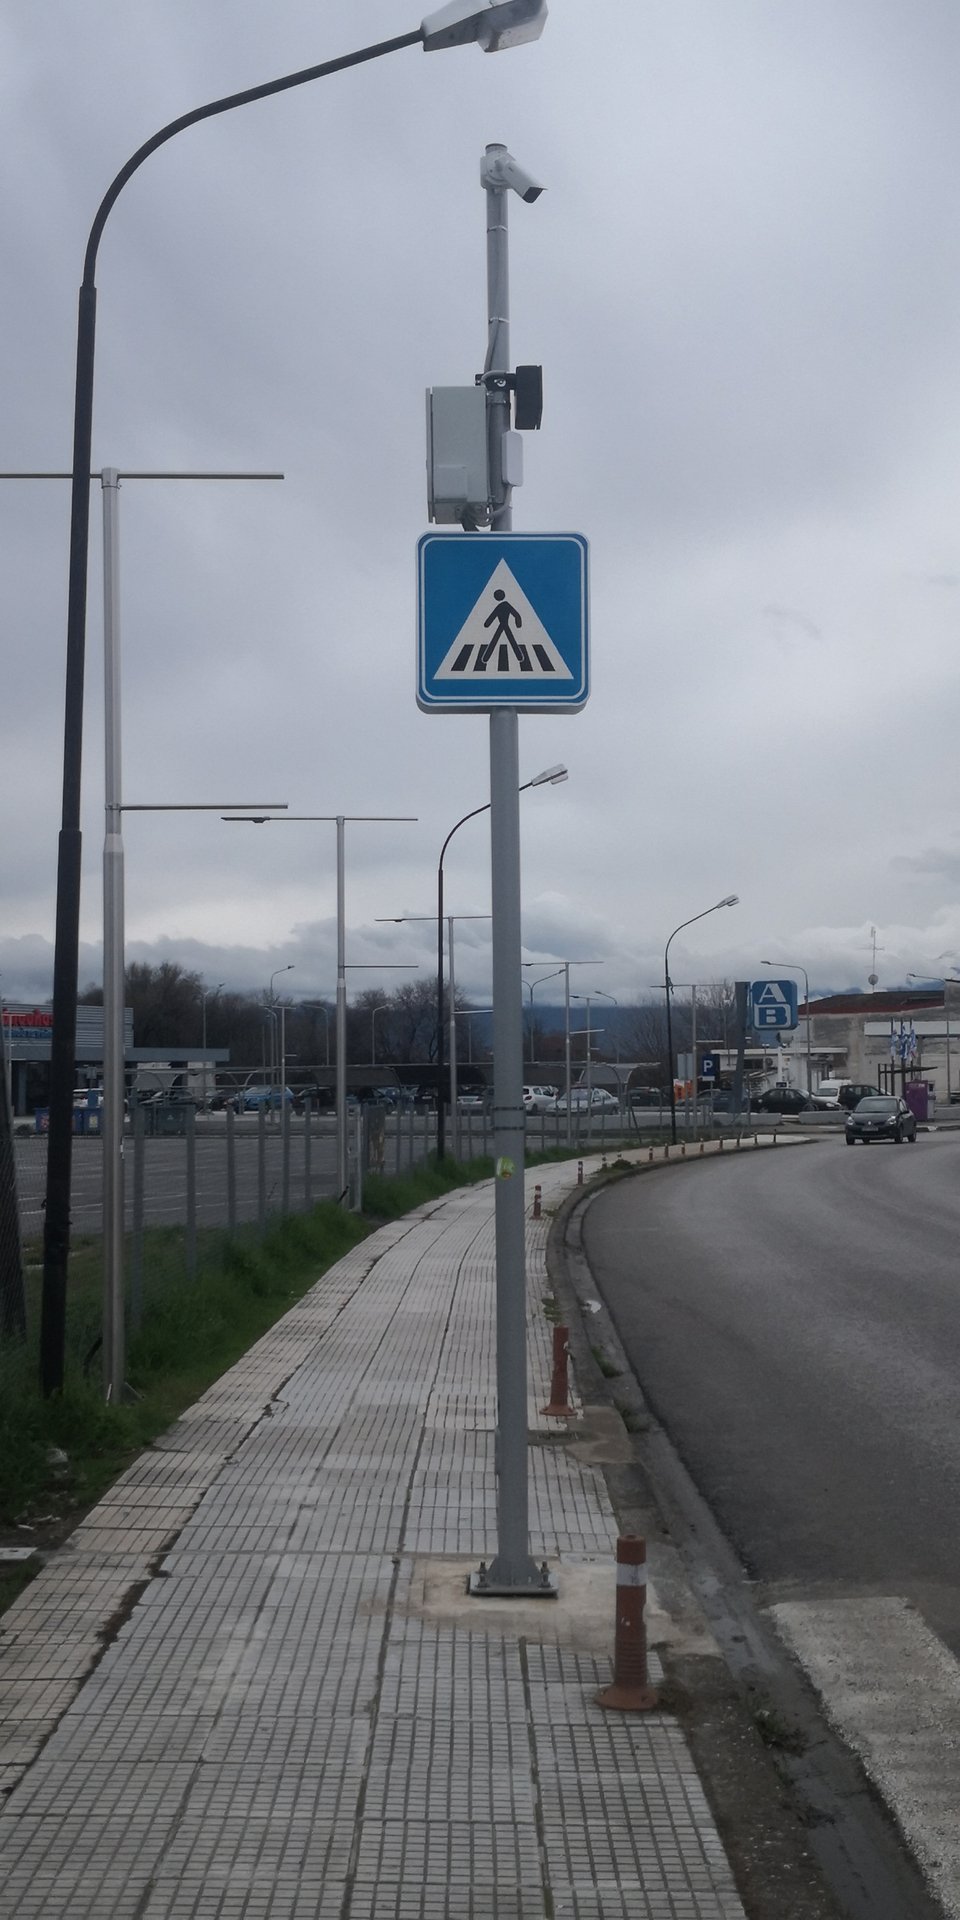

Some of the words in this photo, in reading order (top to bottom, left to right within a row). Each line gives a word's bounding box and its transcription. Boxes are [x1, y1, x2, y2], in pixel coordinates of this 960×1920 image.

[758, 983, 787, 1003] A
[754, 1003, 792, 1029] B
[703, 1059, 713, 1073] P
